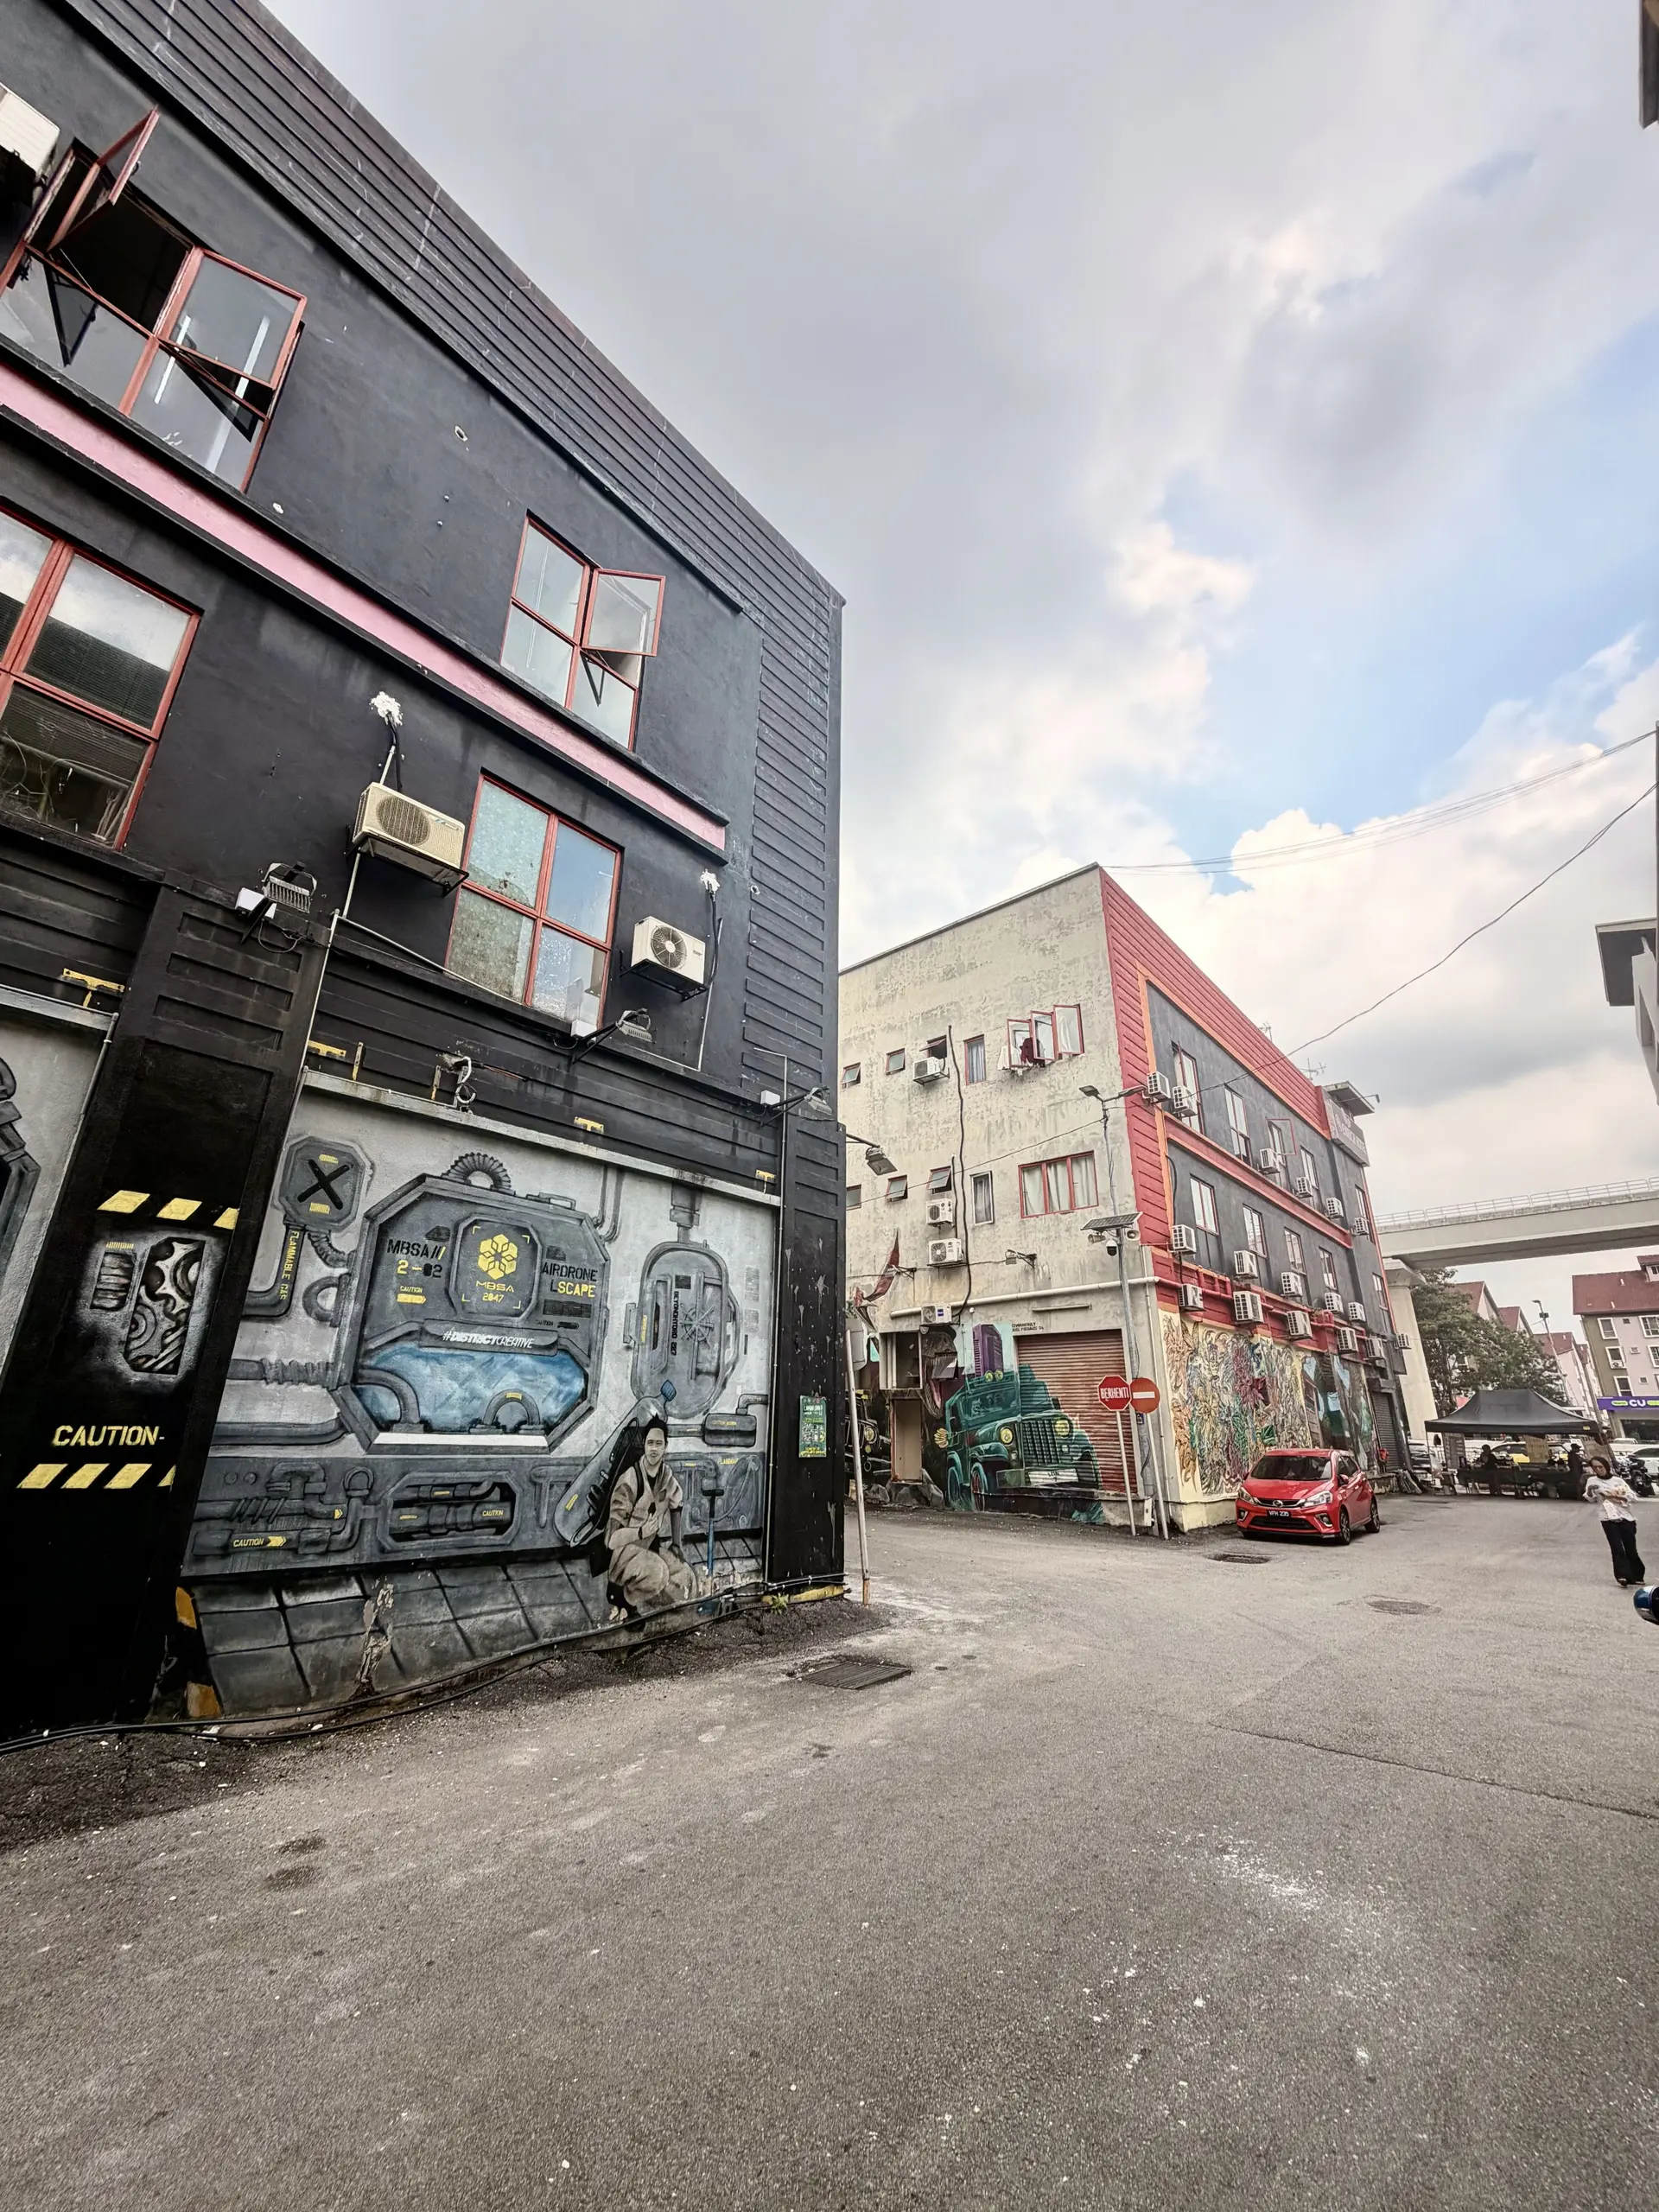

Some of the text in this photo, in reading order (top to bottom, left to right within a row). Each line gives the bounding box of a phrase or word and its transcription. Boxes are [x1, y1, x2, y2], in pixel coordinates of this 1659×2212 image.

[542, 1262, 598, 1282] AIRDRONE
[399, 1285, 423, 1294] CAUTION
[475, 1280, 515, 1293] MBSA
[1099, 1386, 1129, 1402] BERHENTI
[232, 1538, 264, 1548] CAUTION
